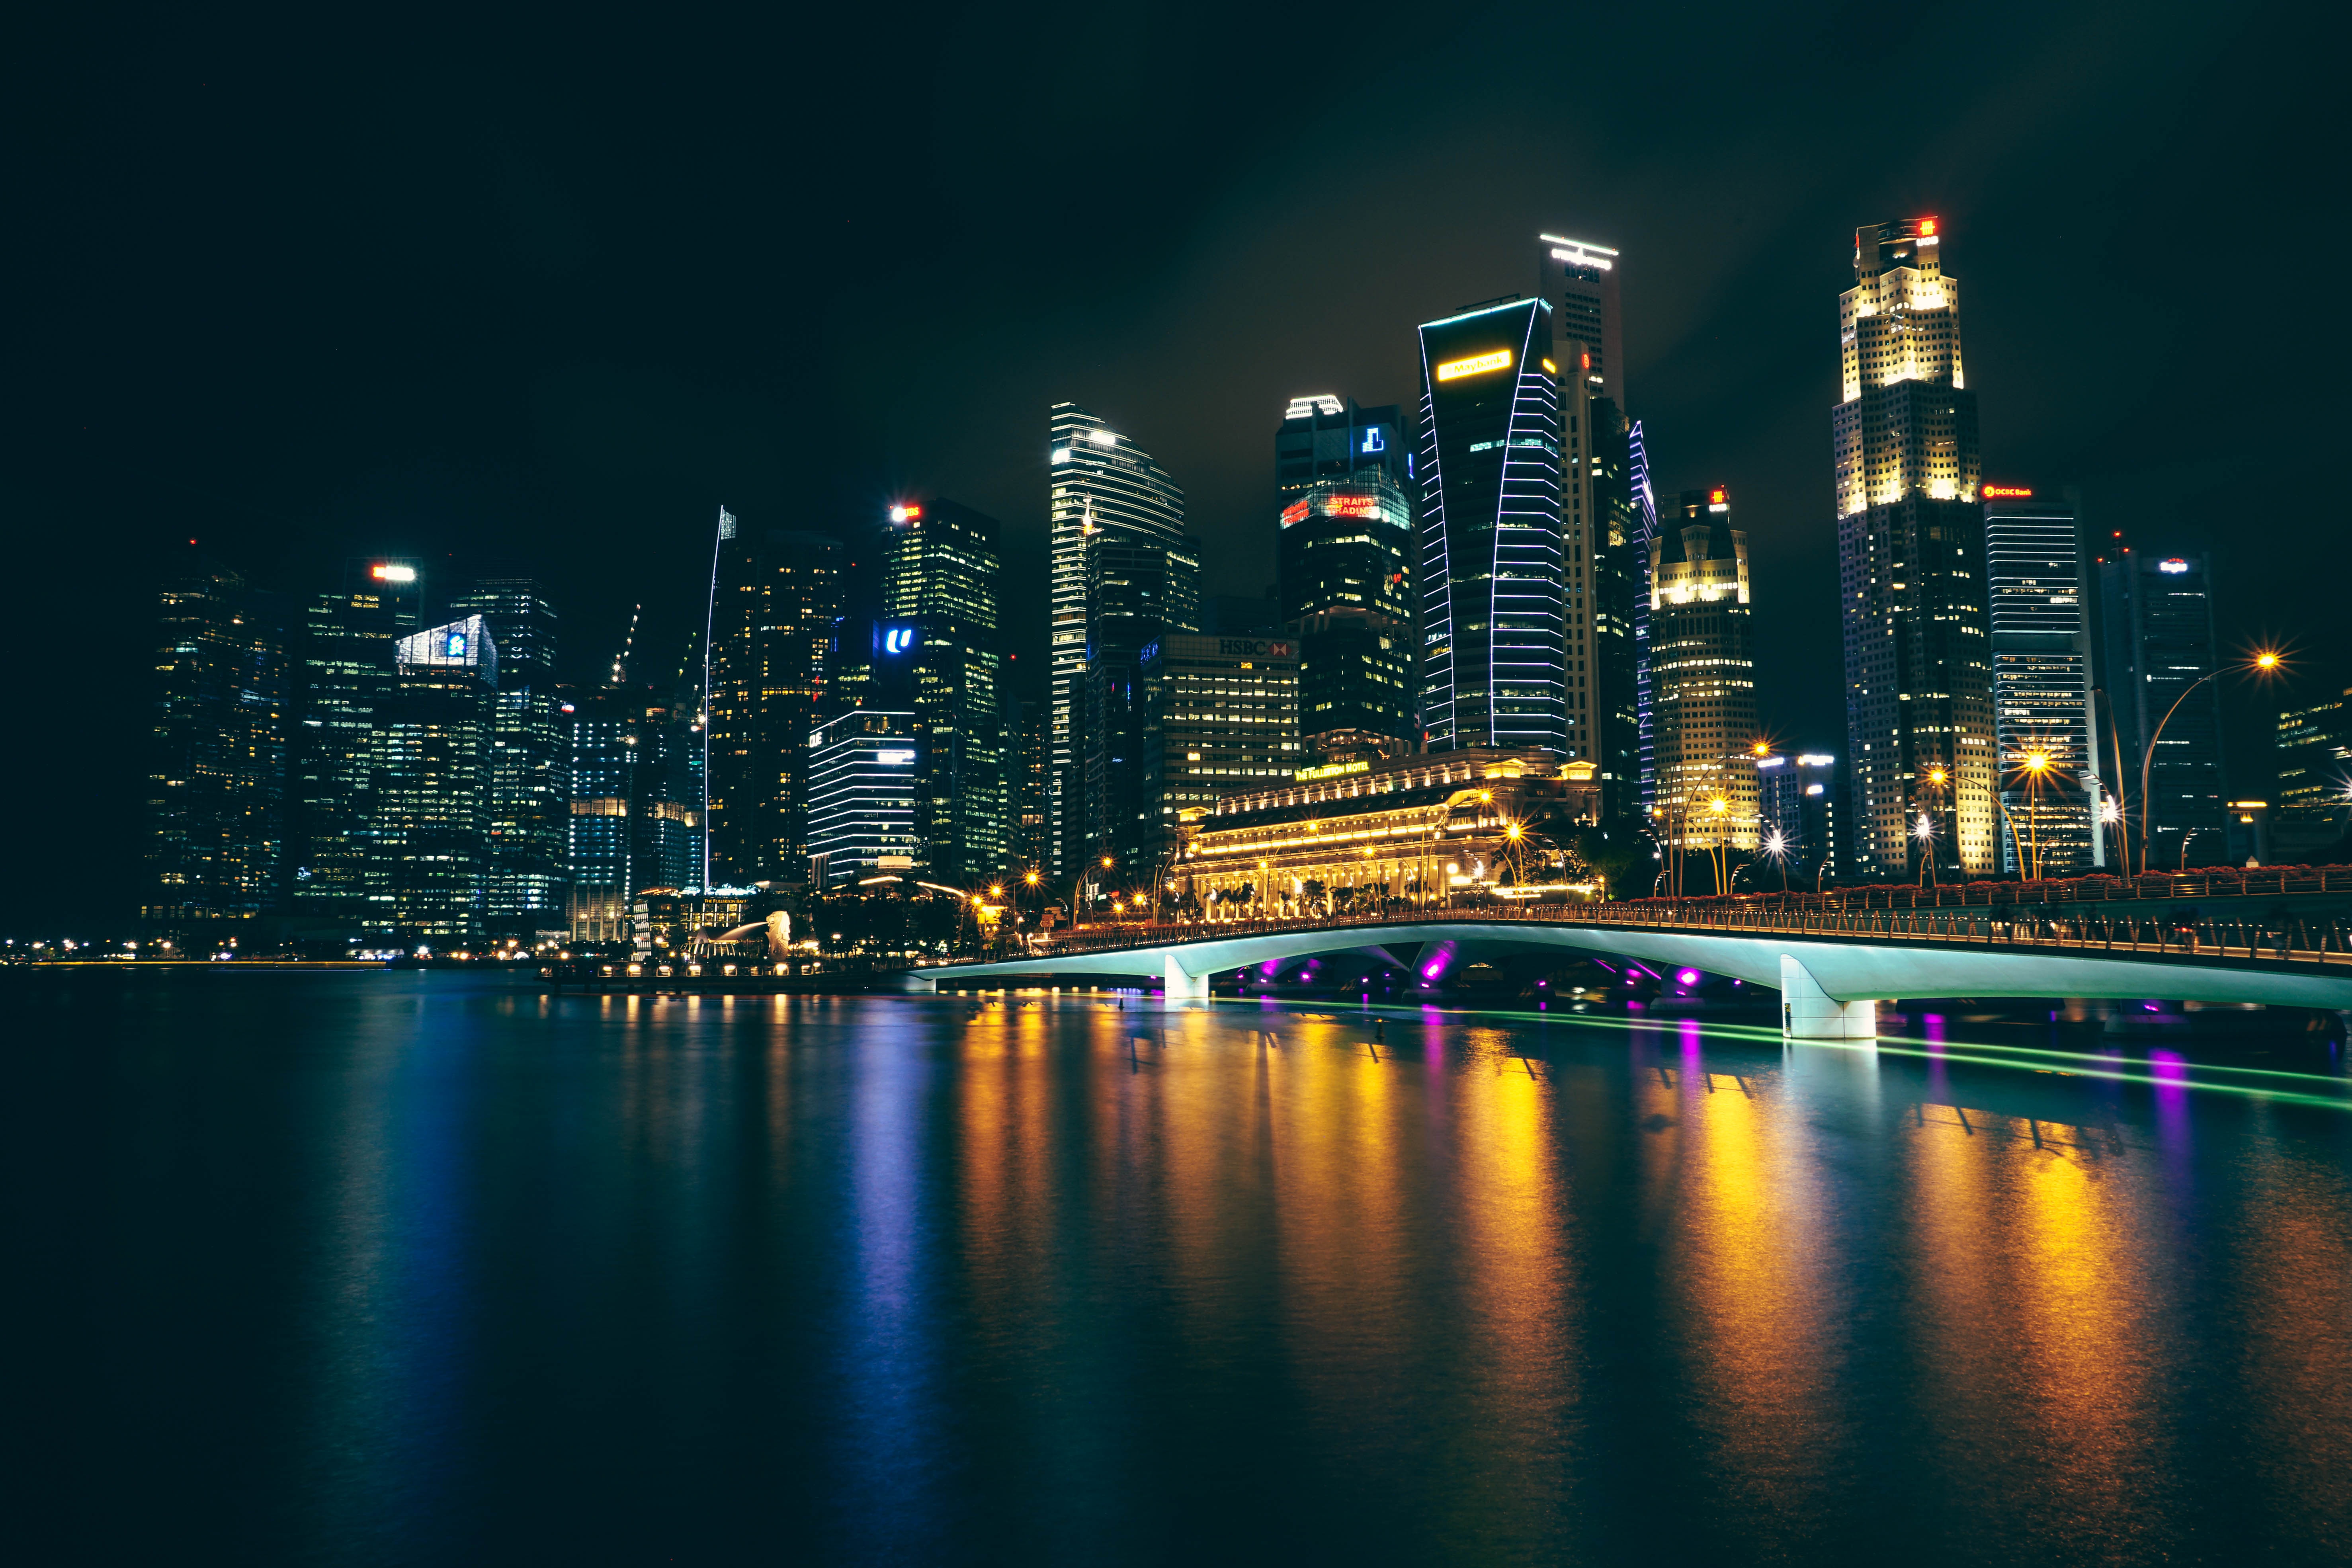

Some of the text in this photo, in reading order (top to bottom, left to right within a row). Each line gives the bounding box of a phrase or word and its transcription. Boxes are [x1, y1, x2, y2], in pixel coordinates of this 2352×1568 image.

[1454, 355, 1502, 373] Maybank
[1330, 497, 1374, 506] STRAITS
[1330, 506, 1373, 515] TRADING
[1219, 639, 1266, 656] HSBC
[1295, 761, 1369, 781] THE FULLERTON HOTEL
